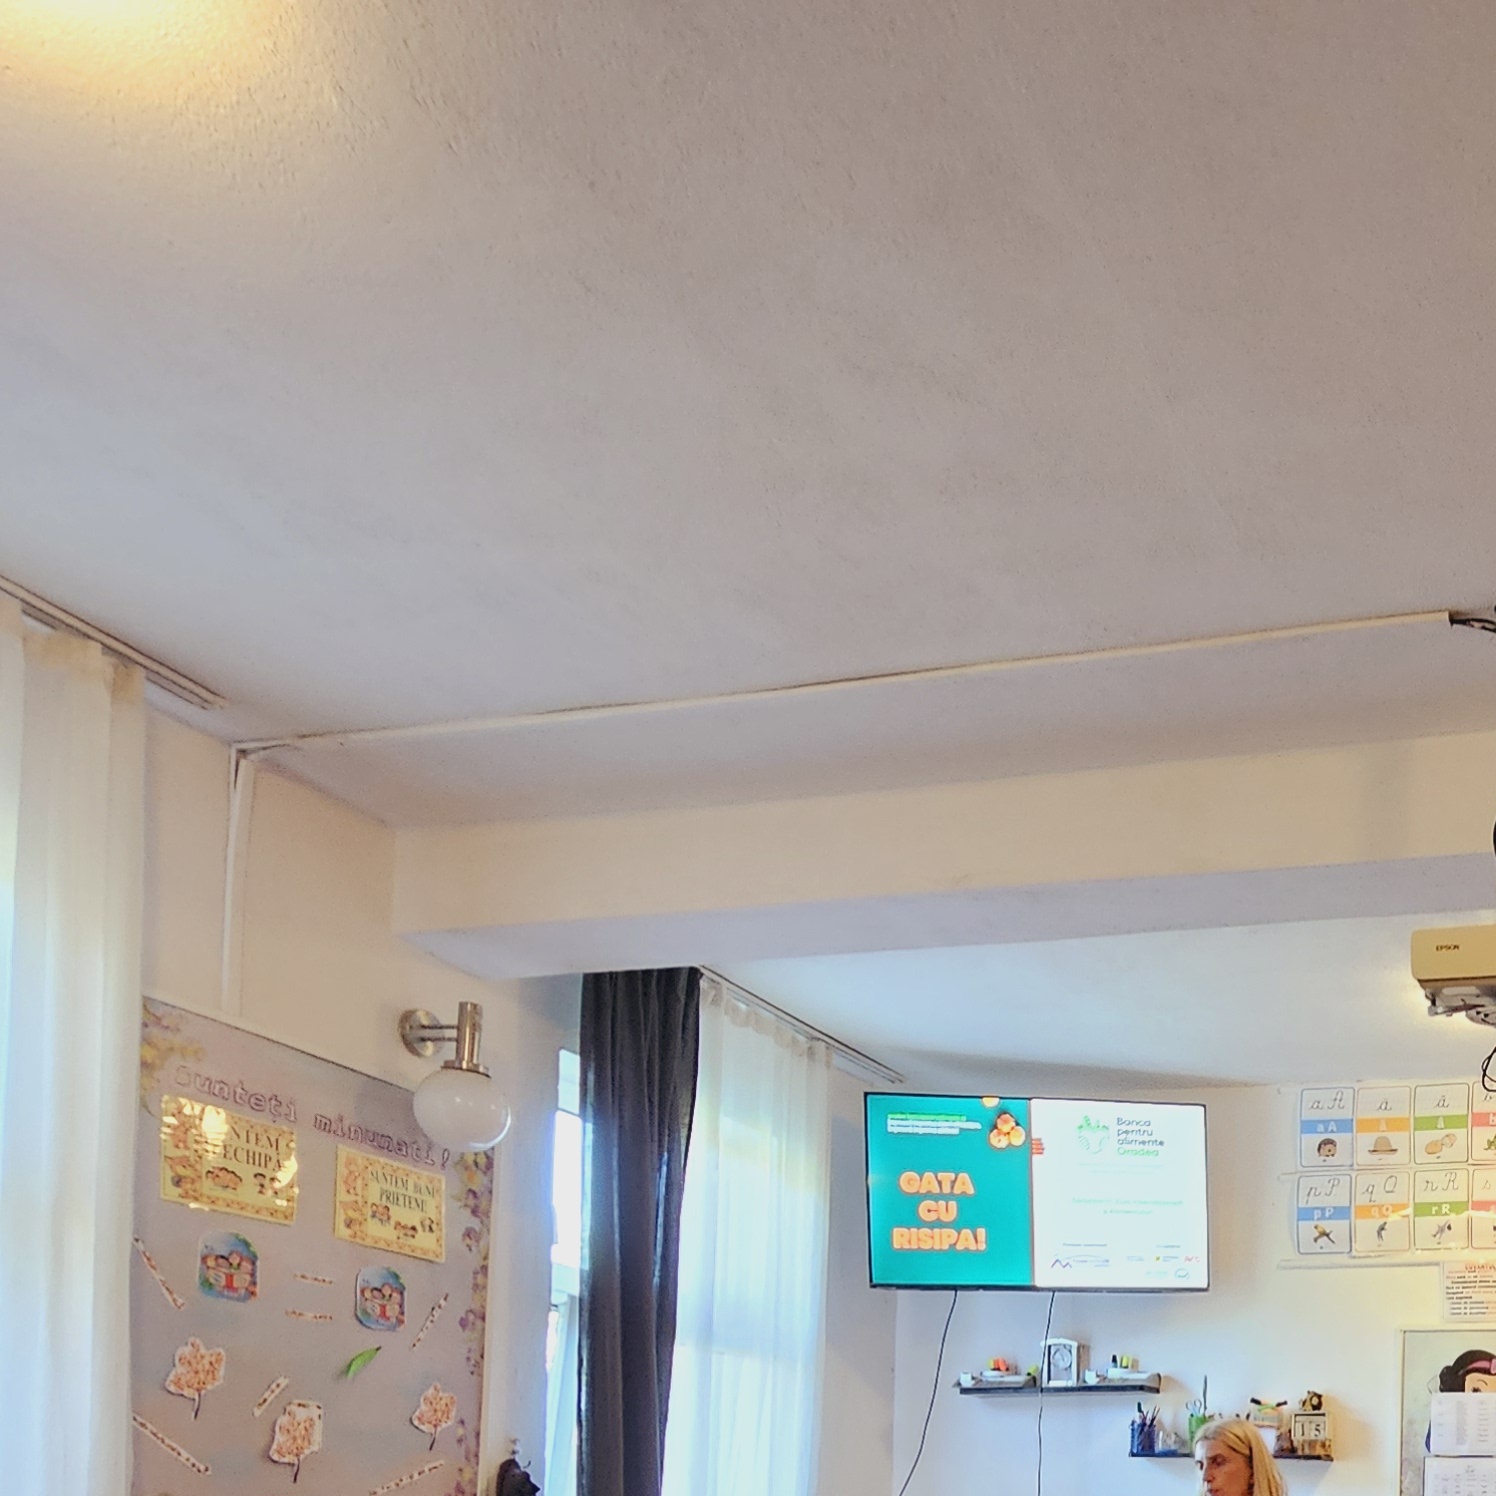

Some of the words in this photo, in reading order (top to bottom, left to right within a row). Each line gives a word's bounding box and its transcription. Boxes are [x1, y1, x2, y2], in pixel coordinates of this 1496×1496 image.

[1436, 944, 1460, 952] EPSON
[1117, 1117, 1151, 1127] Banca
[899, 1171, 975, 1195] GATA
[918, 1200, 957, 1222] CU
[893, 1227, 986, 1251] RISIPA!
